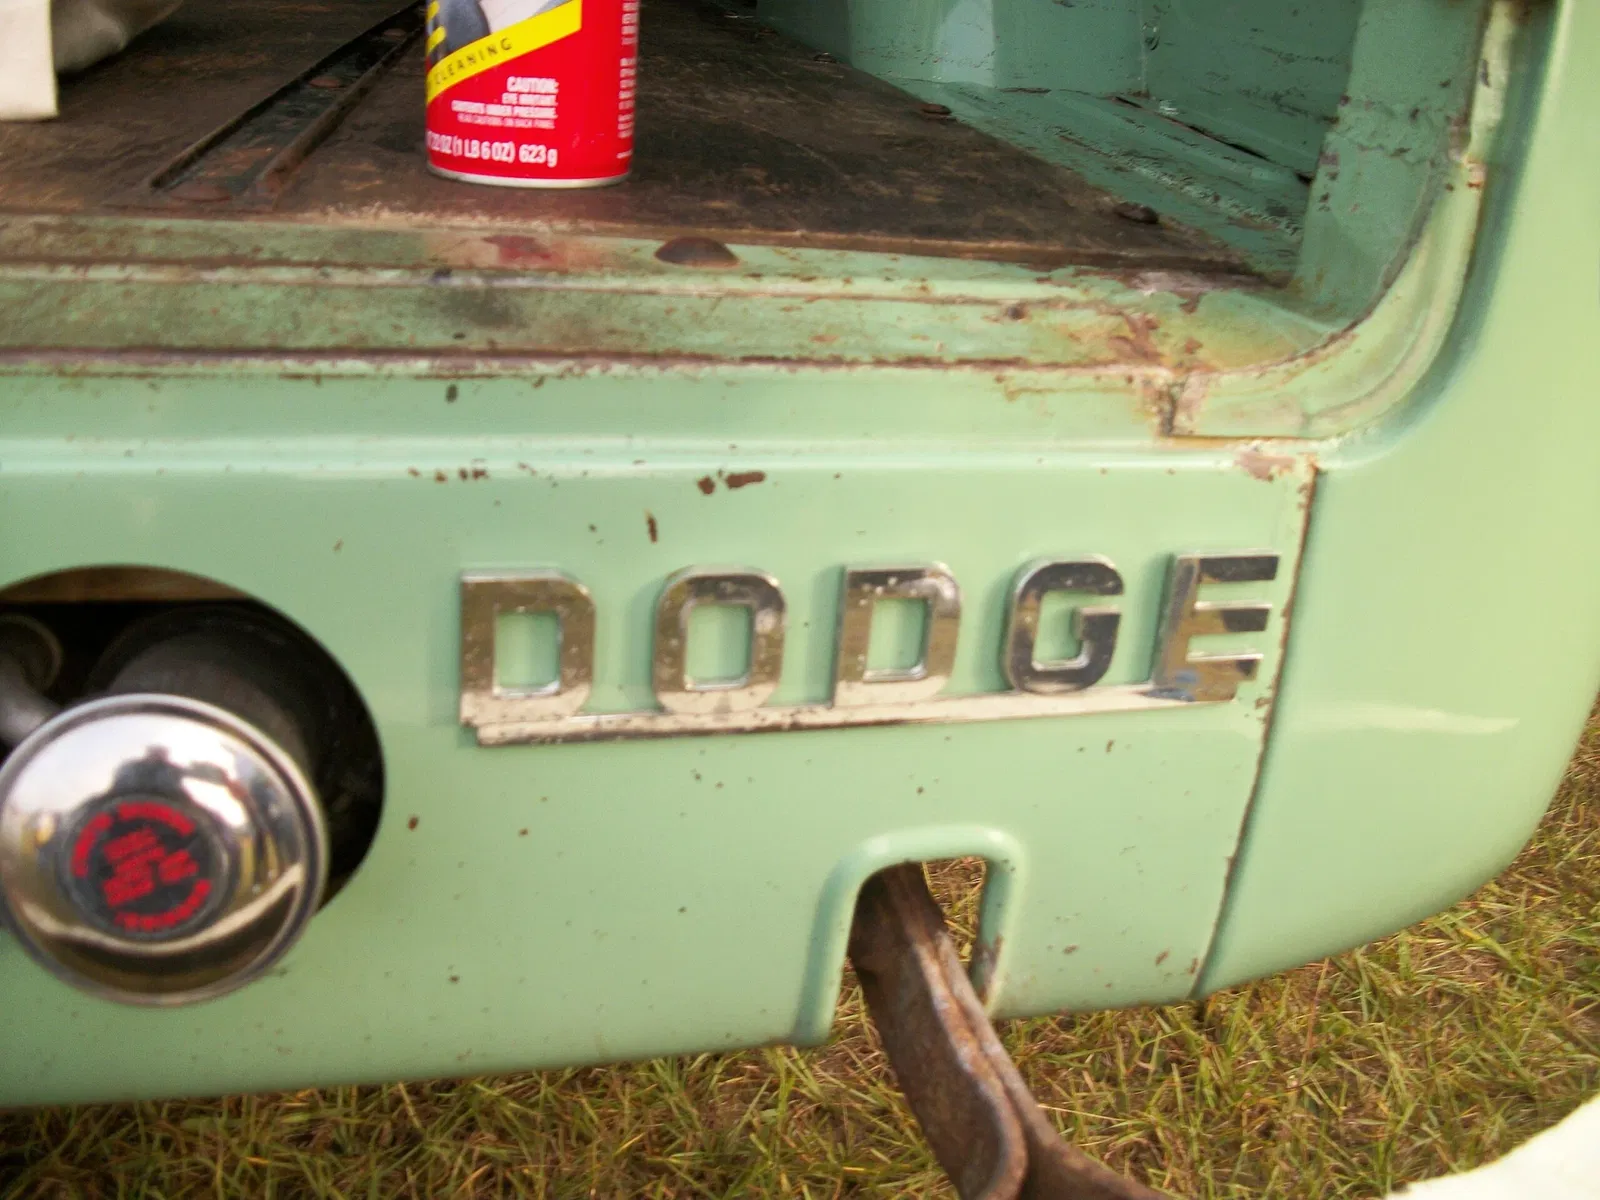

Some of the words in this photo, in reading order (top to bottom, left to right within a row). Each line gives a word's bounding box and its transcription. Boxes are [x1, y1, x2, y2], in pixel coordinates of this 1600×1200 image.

[434, 37, 513, 85] CLEANING
[464, 138, 480, 159] LB
[481, 141, 491, 160] 6
[460, 553, 1281, 724] DODGE
